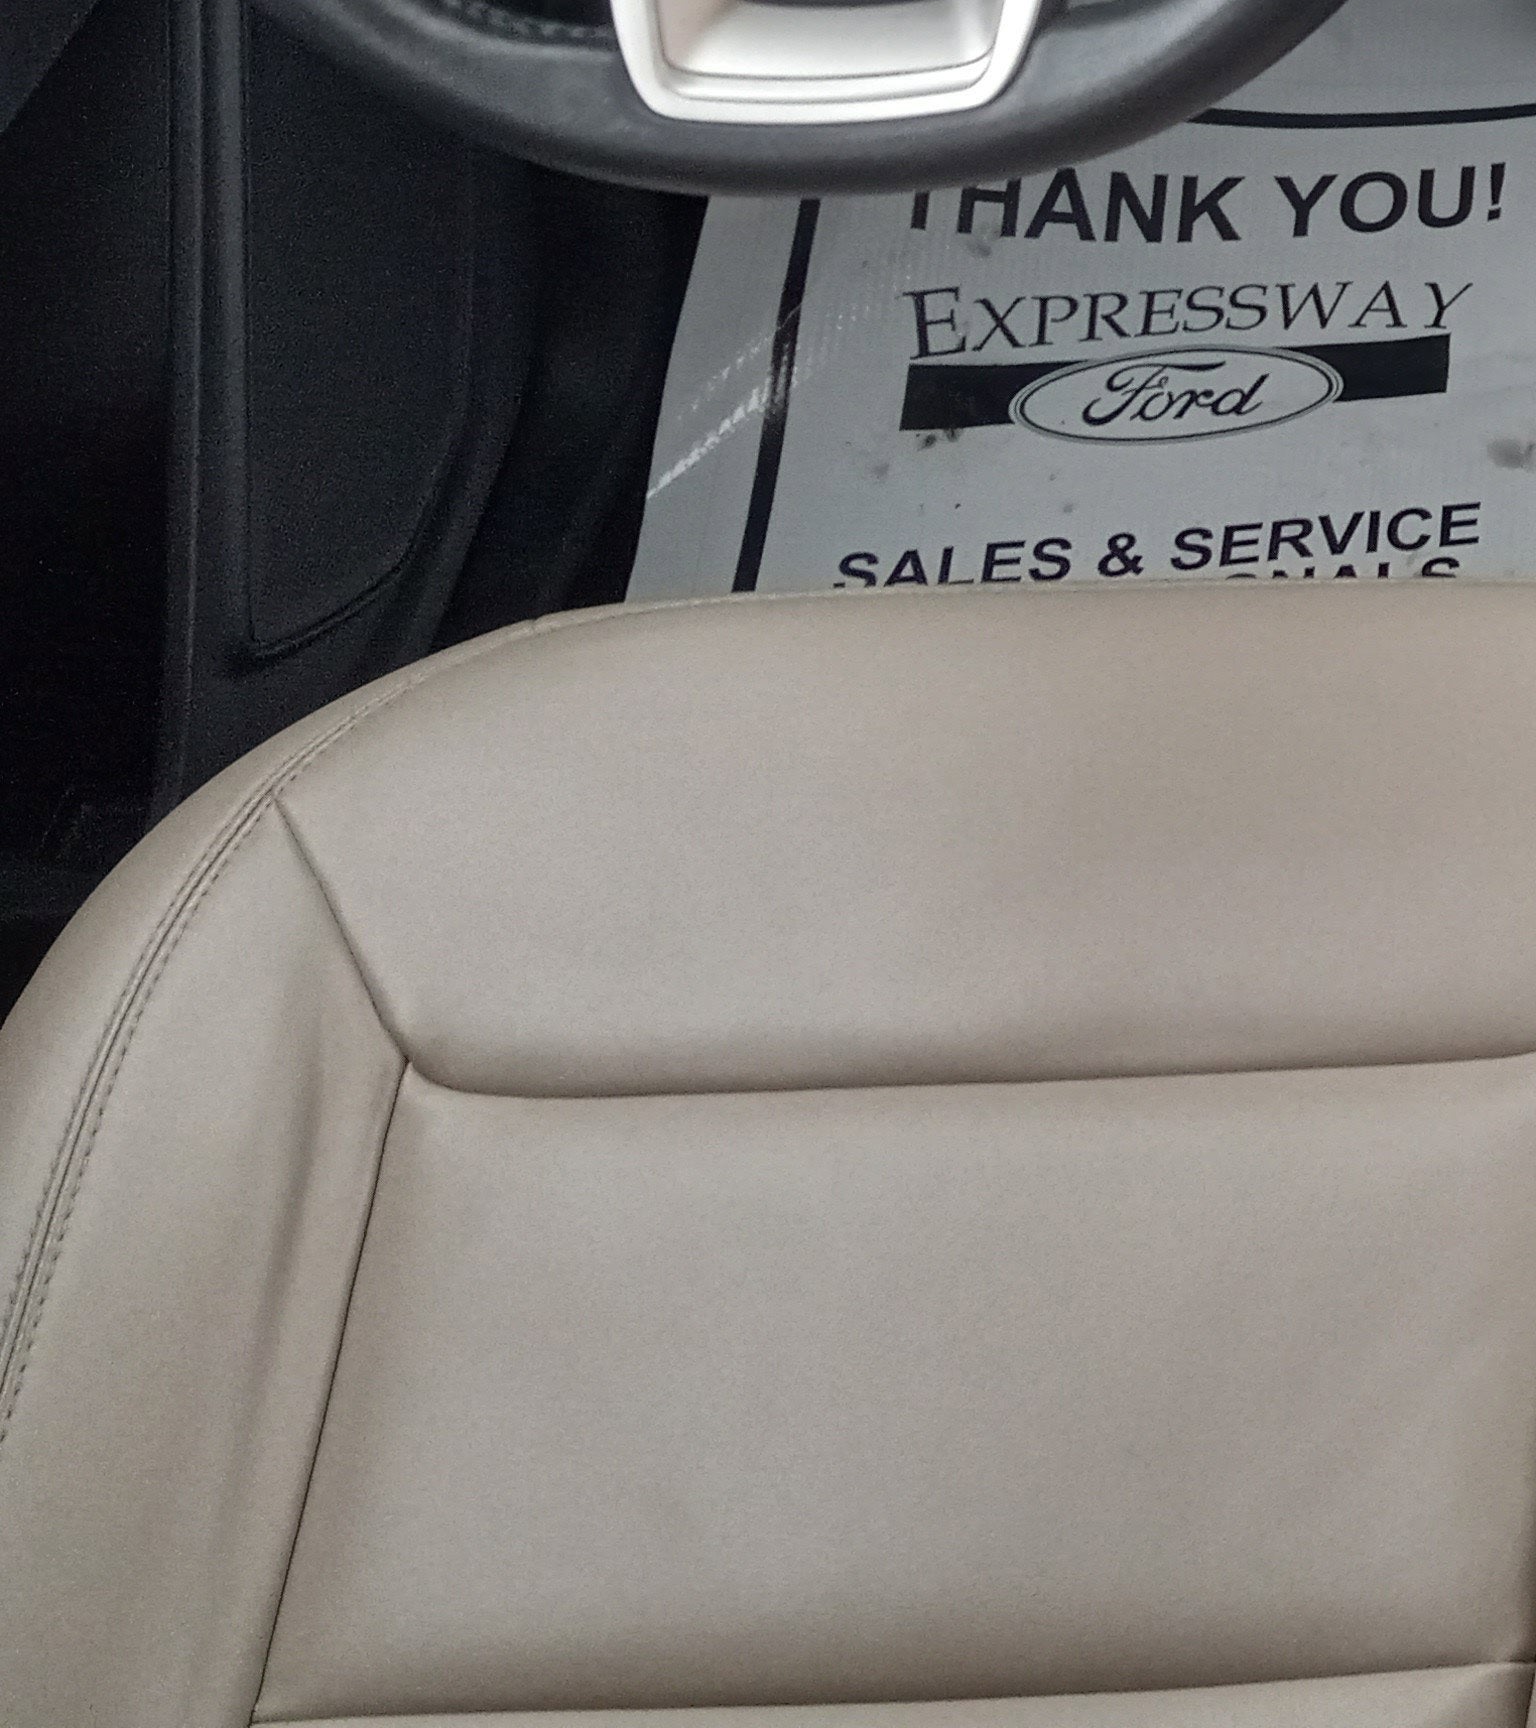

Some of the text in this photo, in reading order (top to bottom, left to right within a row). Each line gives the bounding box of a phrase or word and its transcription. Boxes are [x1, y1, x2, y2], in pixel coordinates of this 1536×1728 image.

[1274, 163, 1506, 238] YOU!
[903, 281, 1475, 360] EXPRESSWAY
[1081, 359, 1270, 426] Ford
[834, 537, 1073, 588] SALES
[1096, 532, 1145, 579] &
[1170, 500, 1482, 571] SERVICE
